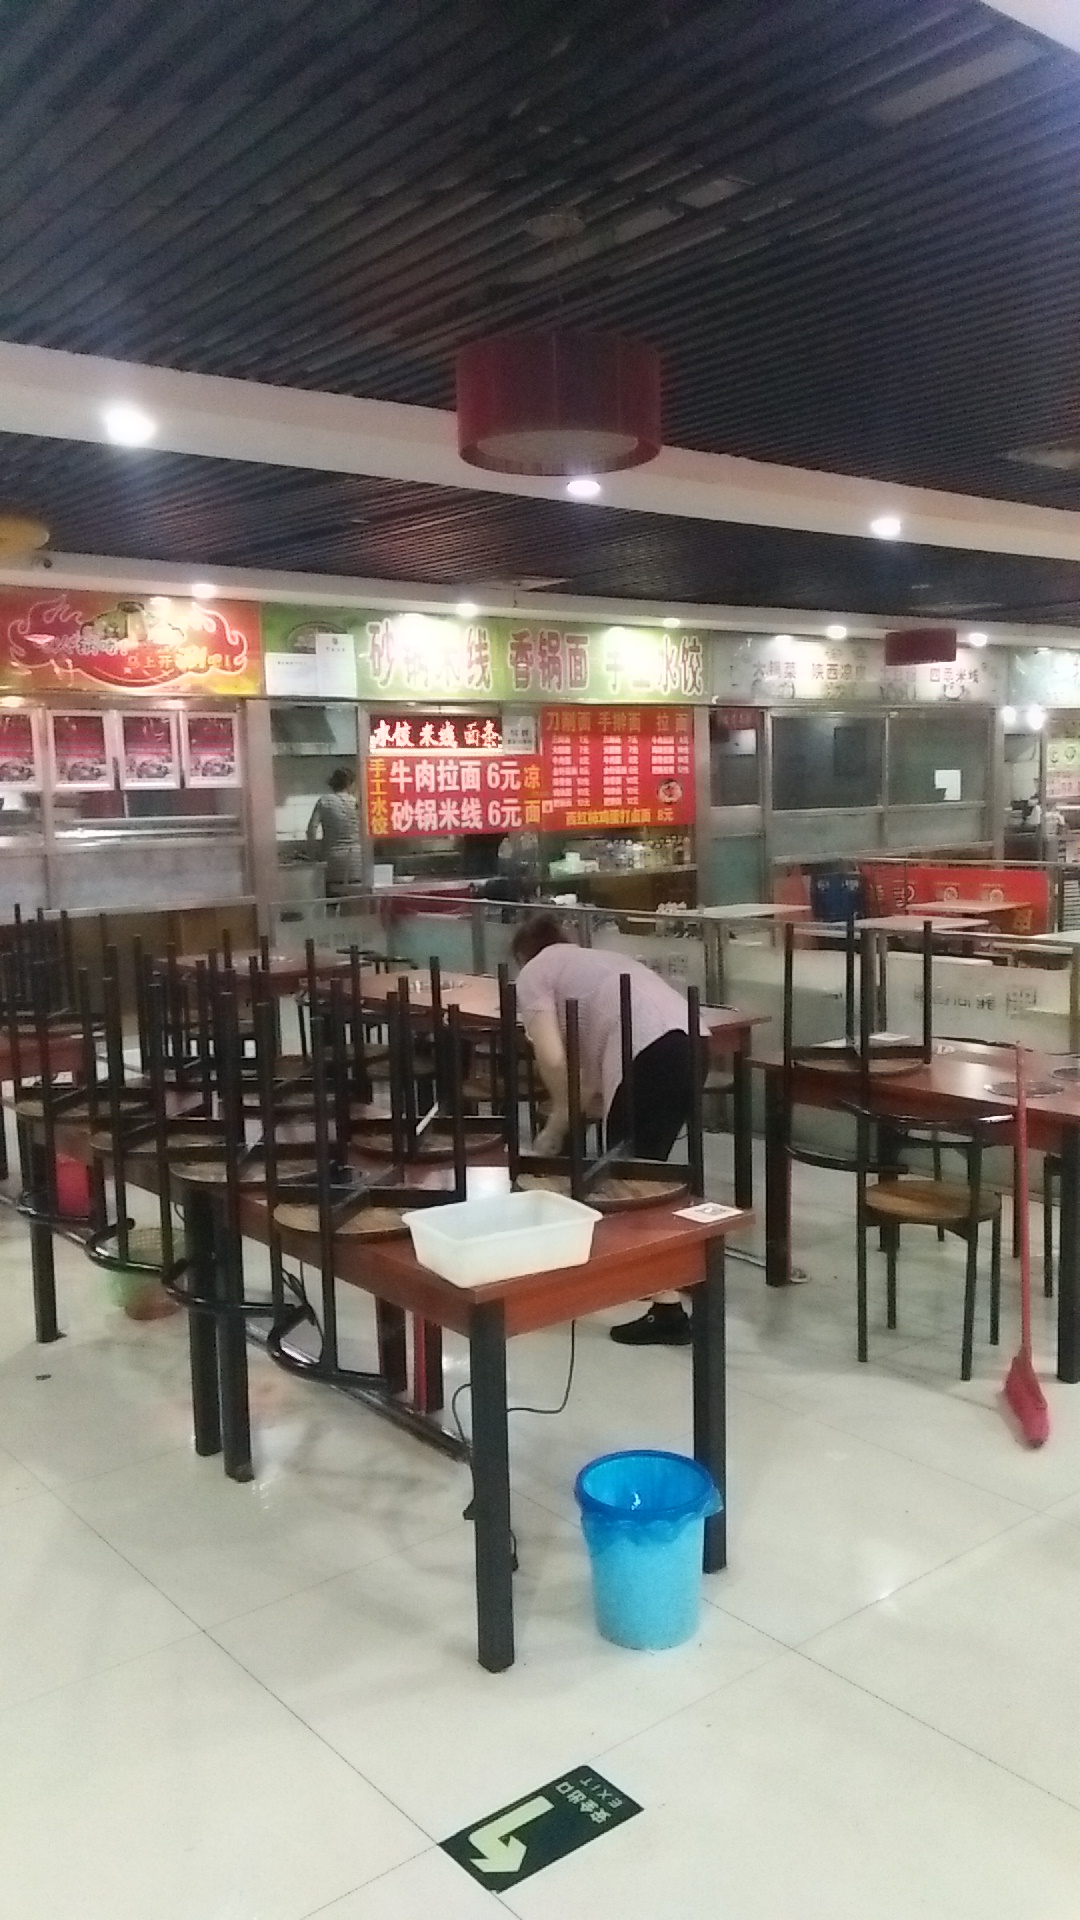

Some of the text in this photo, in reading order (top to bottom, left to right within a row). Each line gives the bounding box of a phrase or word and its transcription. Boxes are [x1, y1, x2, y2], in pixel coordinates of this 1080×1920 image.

[508, 629, 589, 692] 香锅面
[373, 719, 501, 749] 水饺 米线 面条
[389, 758, 522, 793] 牛肉拉面 6元
[369, 758, 389, 835] 手工水饺
[390, 797, 523, 833] 砂锅米线 6元
[555, 1780, 612, 1825] 安全出口
[579, 1776, 624, 1810] EXIT
